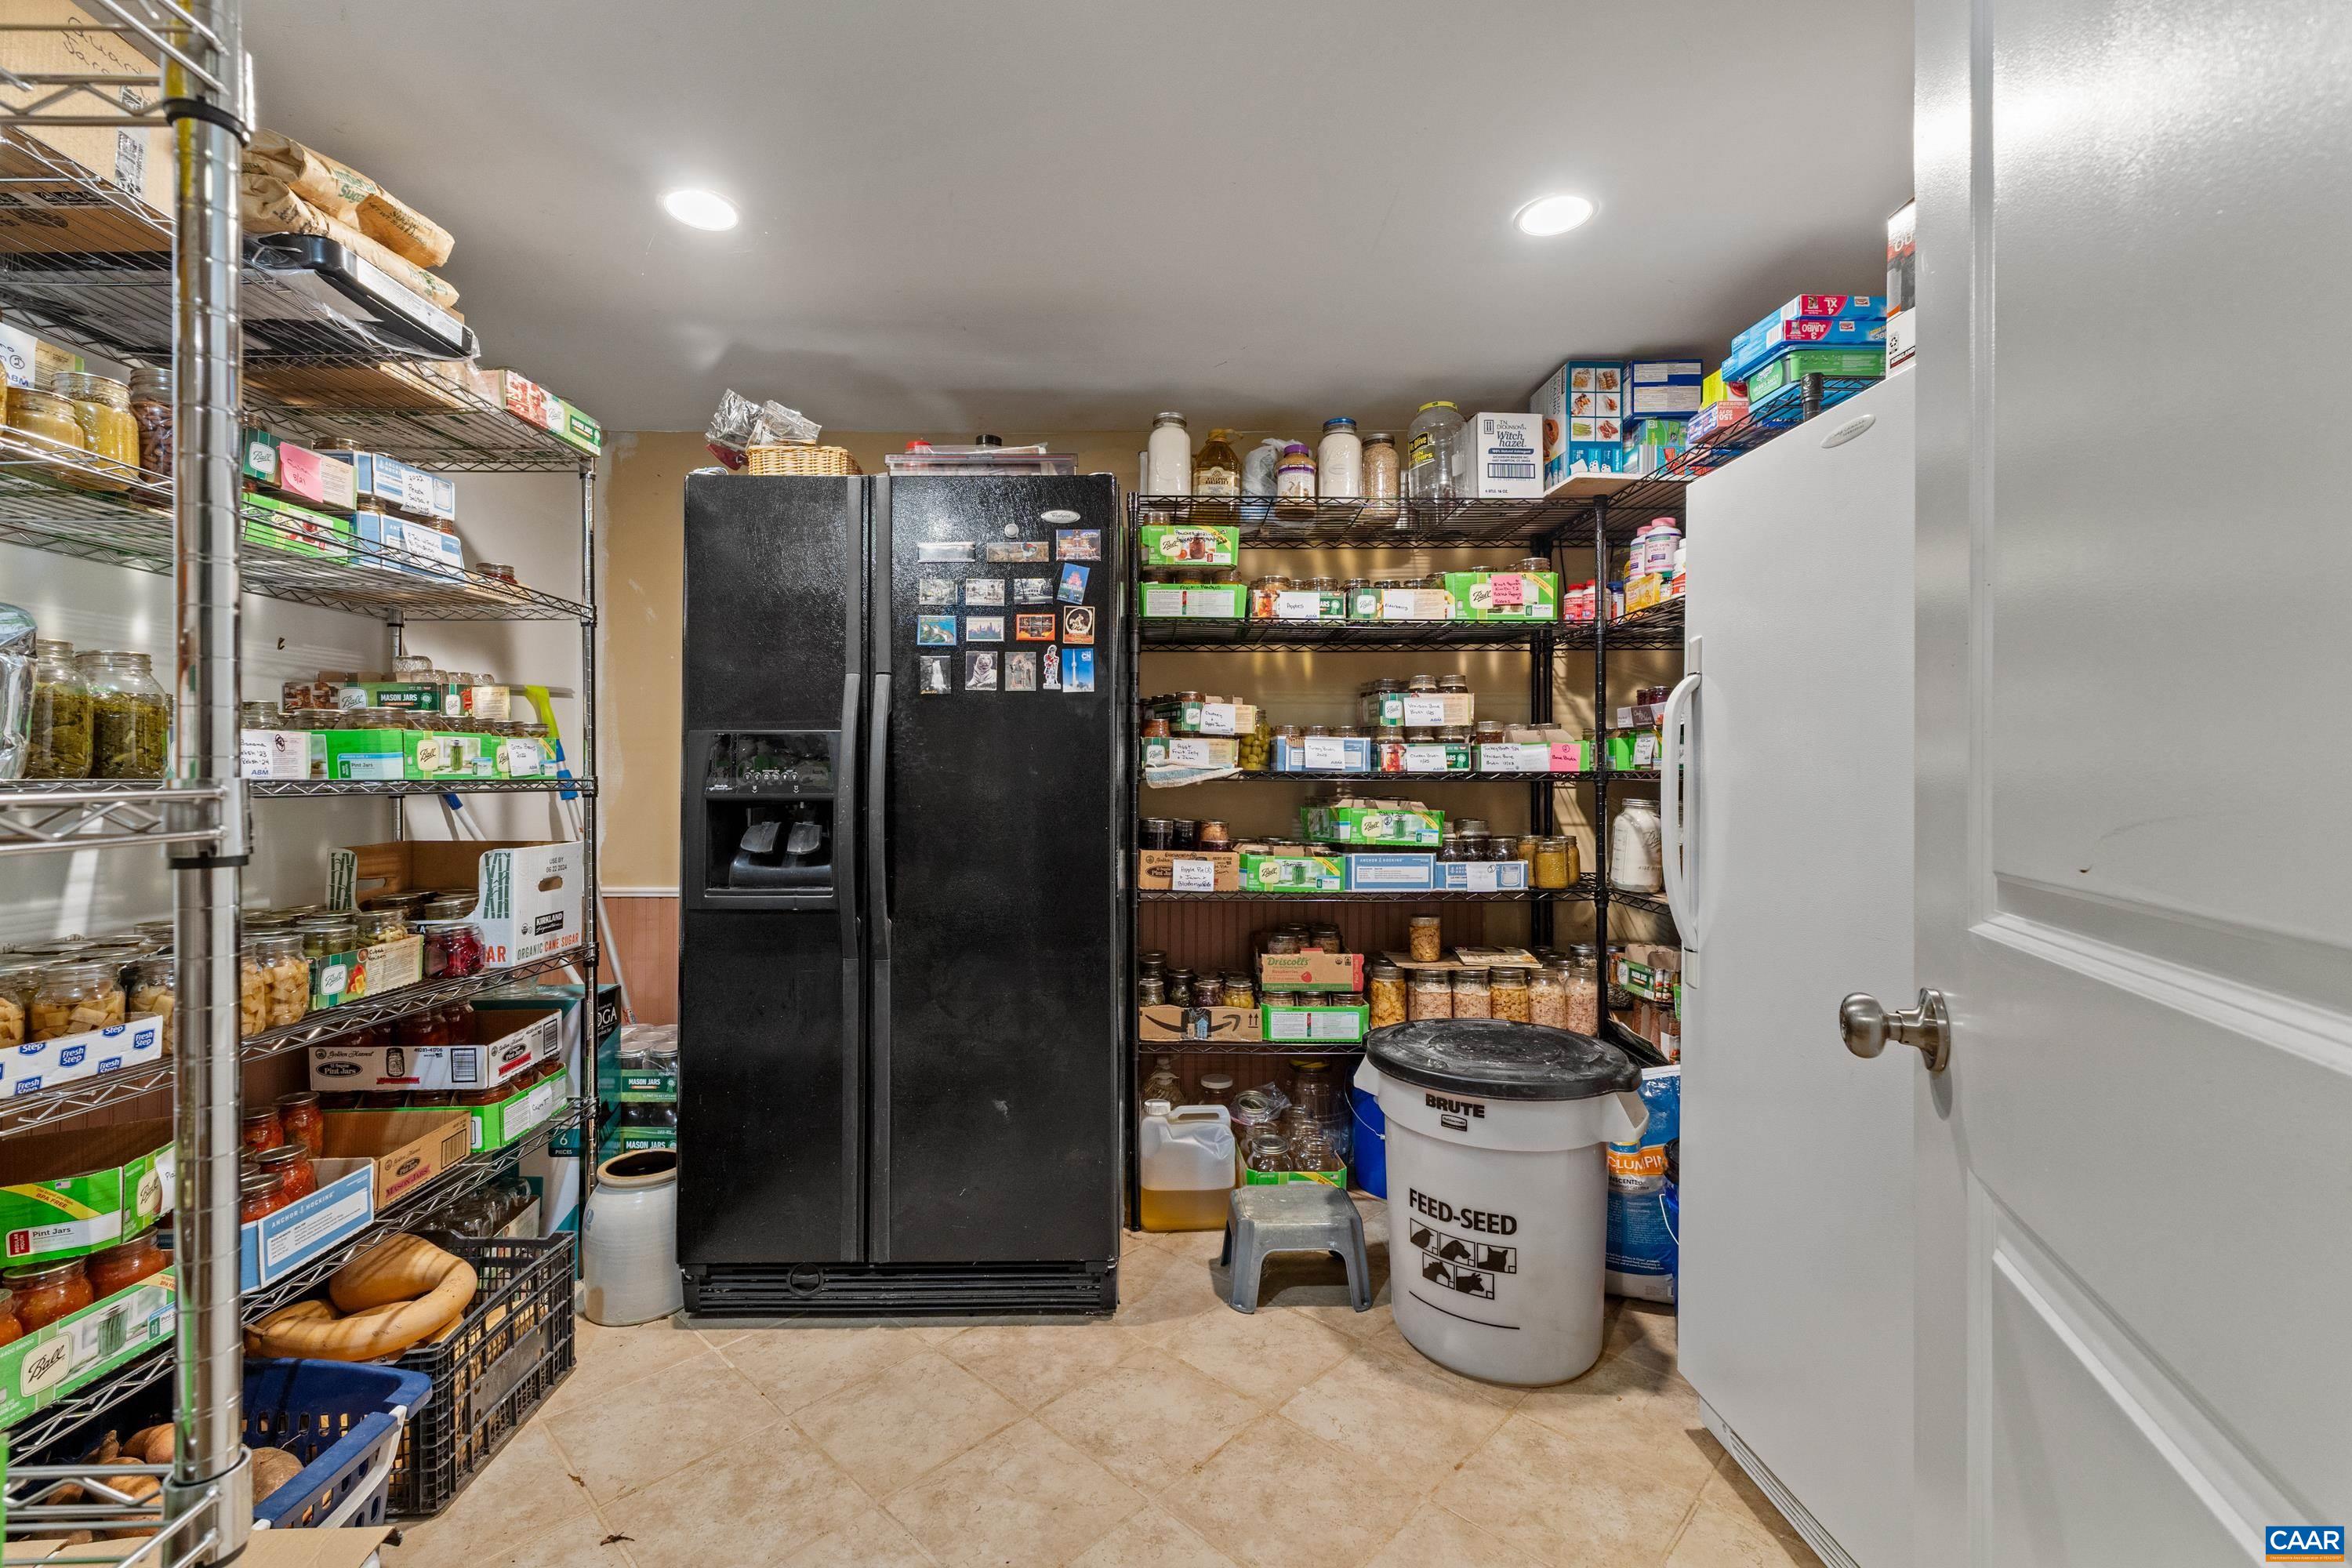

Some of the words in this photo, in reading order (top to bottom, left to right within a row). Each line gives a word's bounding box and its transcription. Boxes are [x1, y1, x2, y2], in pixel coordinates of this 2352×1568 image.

[1802, 324, 1826, 332] JUMBO
[1497, 431, 1523, 440] Witch
[252, 451, 274, 463] Ball
[1472, 590, 1491, 603] Ball
[341, 694, 364, 710] Ball
[419, 747, 437, 763] Ball
[1363, 820, 1380, 831] Ball
[1261, 866, 1279, 877] Ball
[535, 913, 564, 926] KIRKLAND
[517, 942, 543, 960] ORGANIC
[544, 936, 559, 952] CANE
[561, 933, 579, 947] SUGAR
[1267, 956, 1309, 966] Driscoll's
[325, 971, 344, 987] Ball
[105, 1025, 124, 1036] Step
[135, 1031, 154, 1041] Fresh
[21, 1043, 44, 1054] Step
[136, 1037, 153, 1048] Step
[62, 1047, 84, 1058] Fresh
[327, 1051, 347, 1059] Golden
[348, 1050, 375, 1058] Harvest
[63, 1054, 83, 1065] Step
[100, 1058, 120, 1070] Fresh
[17, 1078, 40, 1091] Fresh
[1425, 1094, 1485, 1118] BRUTE
[560, 1133, 568, 1146] 6
[140, 1176, 160, 1206] Ball
[36, 1192, 51, 1203] BPA
[50, 1198, 68, 1210] FREE
[271, 1210, 299, 1229] ANCHOR
[306, 1191, 334, 1210] HOCKING
[1410, 1187, 1518, 1236] FEED-SEED
[32, 1229, 49, 1239] Pint
[52, 1225, 71, 1236] Jars
[28, 1346, 65, 1383] Ball
